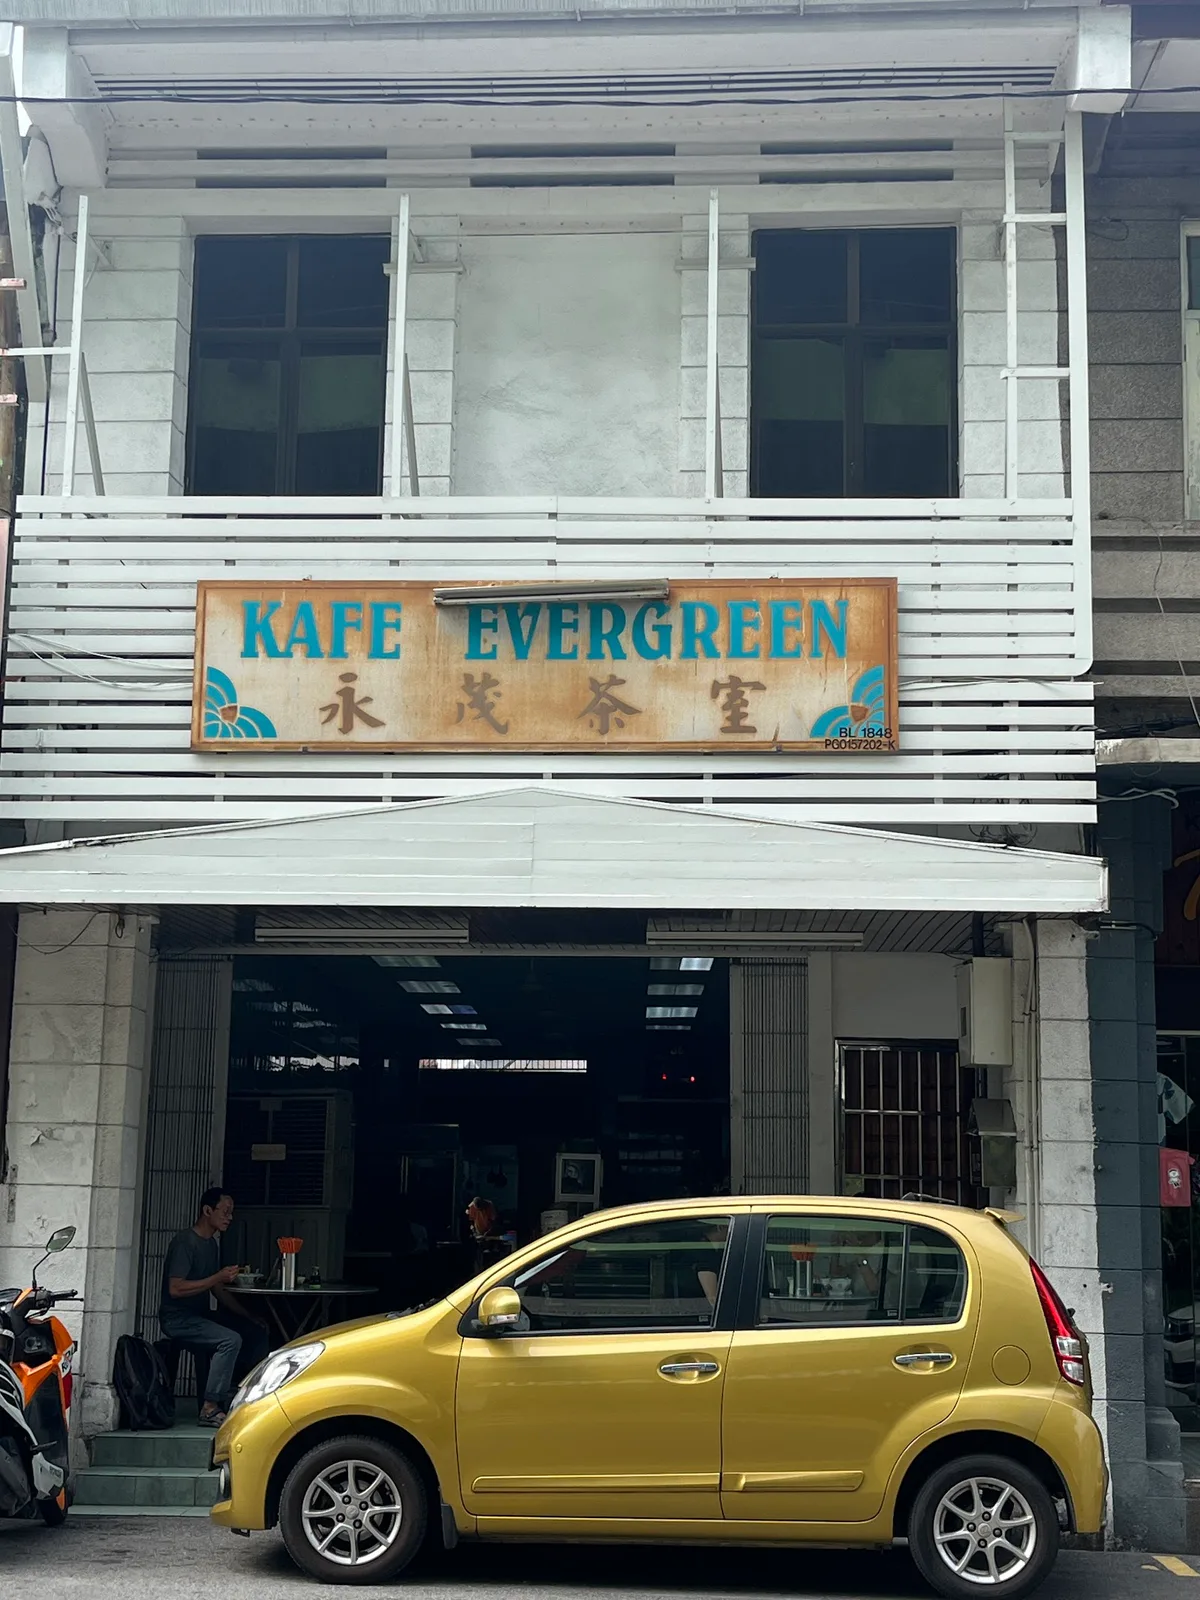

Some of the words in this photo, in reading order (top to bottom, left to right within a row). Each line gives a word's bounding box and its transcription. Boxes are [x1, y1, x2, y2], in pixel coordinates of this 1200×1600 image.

[241, 601, 402, 660] KAFE
[465, 600, 848, 660] EVERGREEN
[319, 671, 767, 736] 永茂茶室
[839, 727, 856, 738] BL
[861, 727, 893, 739] 1848
